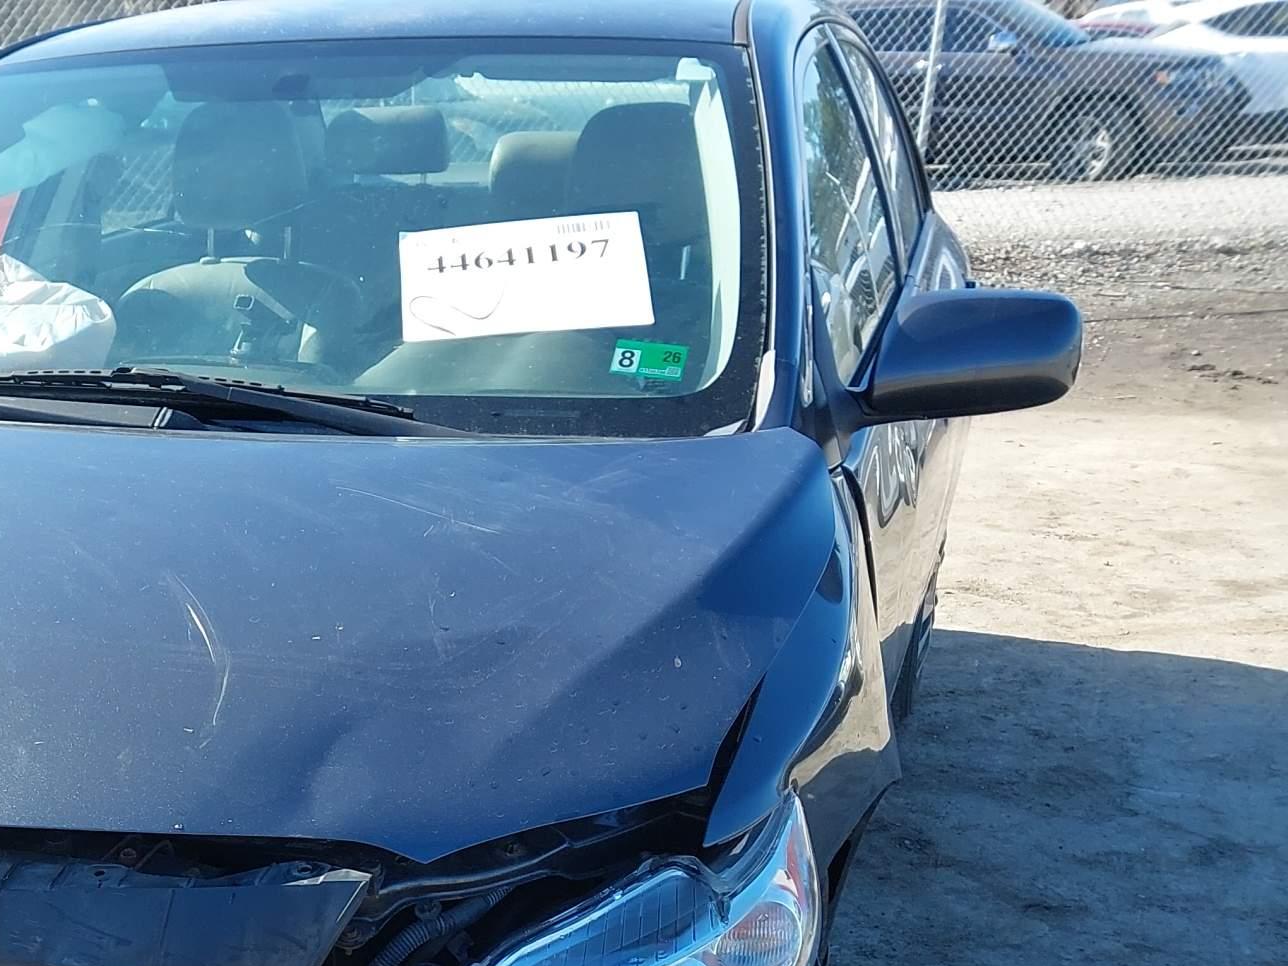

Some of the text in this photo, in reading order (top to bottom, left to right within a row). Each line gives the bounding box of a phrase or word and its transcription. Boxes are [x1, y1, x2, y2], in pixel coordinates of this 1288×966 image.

[427, 238, 610, 274] 44641197
[618, 350, 682, 368] 8 26
